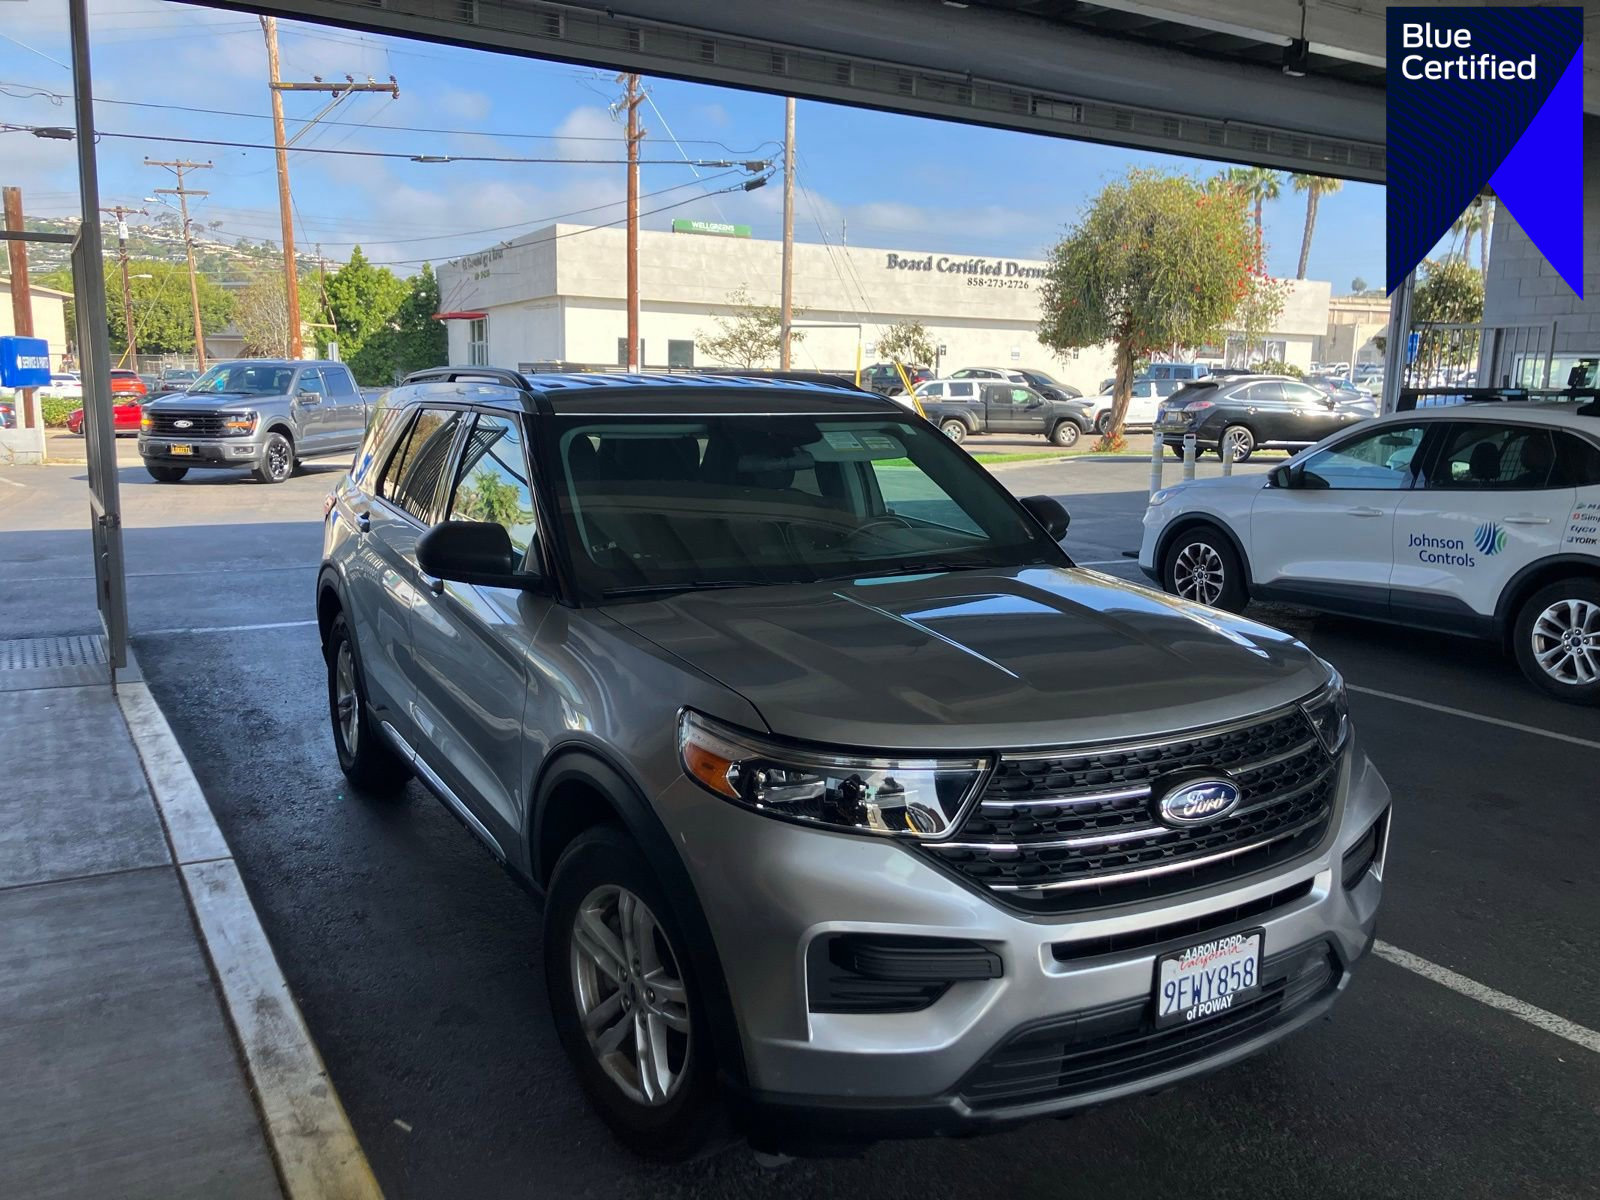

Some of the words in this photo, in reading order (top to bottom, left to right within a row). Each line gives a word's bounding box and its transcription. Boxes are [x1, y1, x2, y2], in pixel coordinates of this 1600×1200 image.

[886, 253, 933, 272] Board
[936, 257, 1002, 276] Certified
[1005, 261, 1047, 279] Derm
[1408, 533, 1464, 551] Johnson
[1570, 524, 1597, 535] tyco
[1575, 535, 1598, 546] YORK
[1419, 550, 1476, 568] Controls
[1183, 786, 1226, 817] Ford
[1183, 941, 1218, 961] AARON
[1219, 933, 1243, 954] FORD
[1163, 956, 1255, 1017] 9FWY858
[1186, 1005, 1197, 1021] of
[1197, 993, 1234, 1017] POWAY
